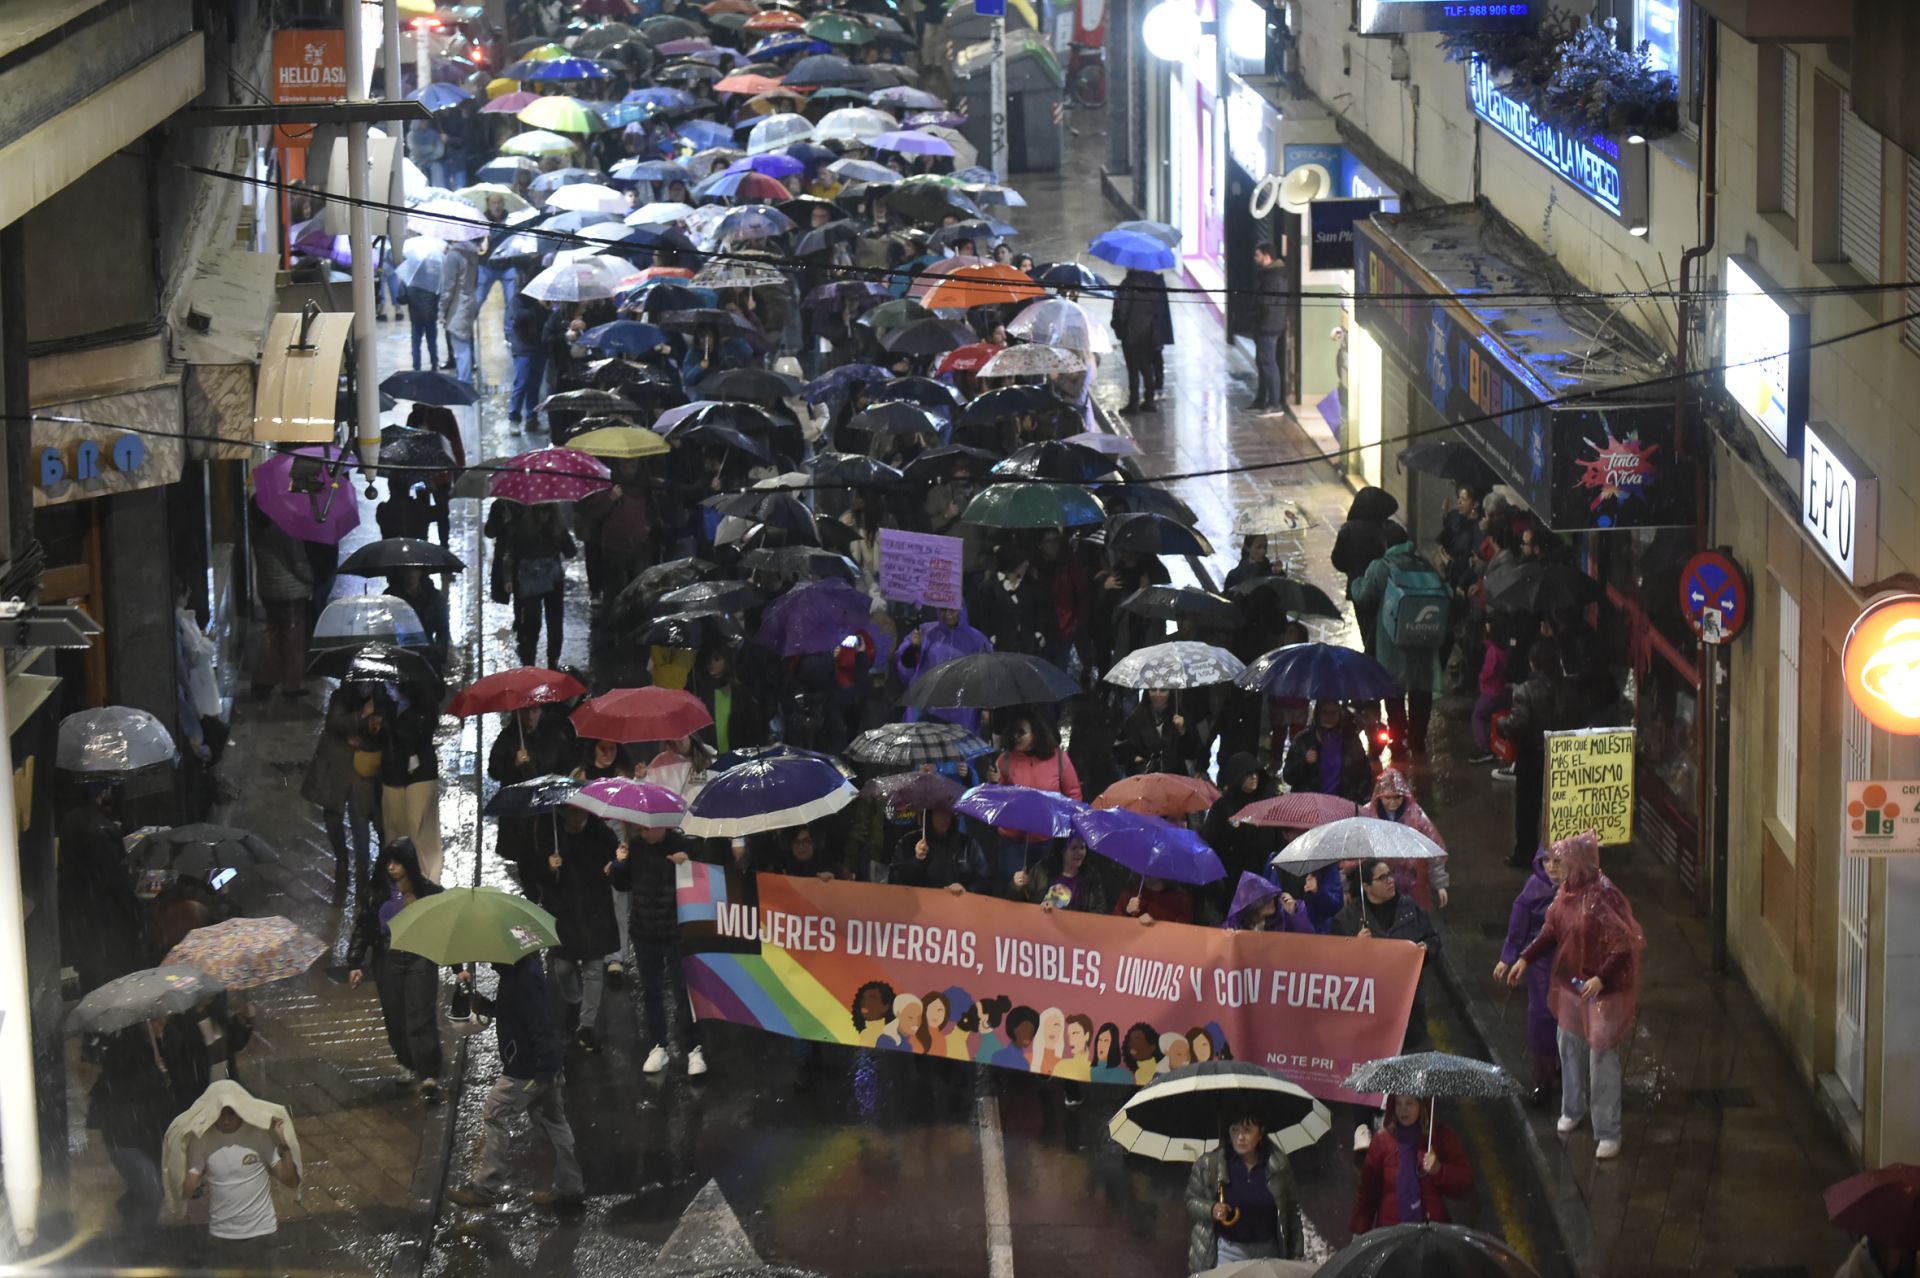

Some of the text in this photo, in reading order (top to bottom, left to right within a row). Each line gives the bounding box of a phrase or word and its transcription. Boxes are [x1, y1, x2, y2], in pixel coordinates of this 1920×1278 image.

[1443, 6, 1467, 17] TLF:
[1469, 6, 1488, 16] 968
[1490, 5, 1508, 15] 906
[279, 66, 320, 84] HELLO
[1559, 131, 1576, 177] LA
[1575, 140, 1621, 206] MERCED
[1315, 231, 1338, 243] Sun
[1808, 444, 1851, 561] EPO
[1551, 734, 1632, 756] ¿POR QUÉ MOLESTA
[1571, 754, 1586, 767] EL
[1551, 764, 1623, 788] FEMINISMO
[1552, 790, 1567, 802] QUE
[1577, 784, 1630, 803] TRATAS
[1551, 800, 1627, 820] VIOLACIONES
[1550, 815, 1622, 834] ASESINATOS
[716, 901, 1376, 1015] MUJERES DIVERSAS, VISIBLES, UNIDAS Y CON FUERZA
[1266, 1051, 1288, 1066] NO
[1290, 1054, 1308, 1067] TE
